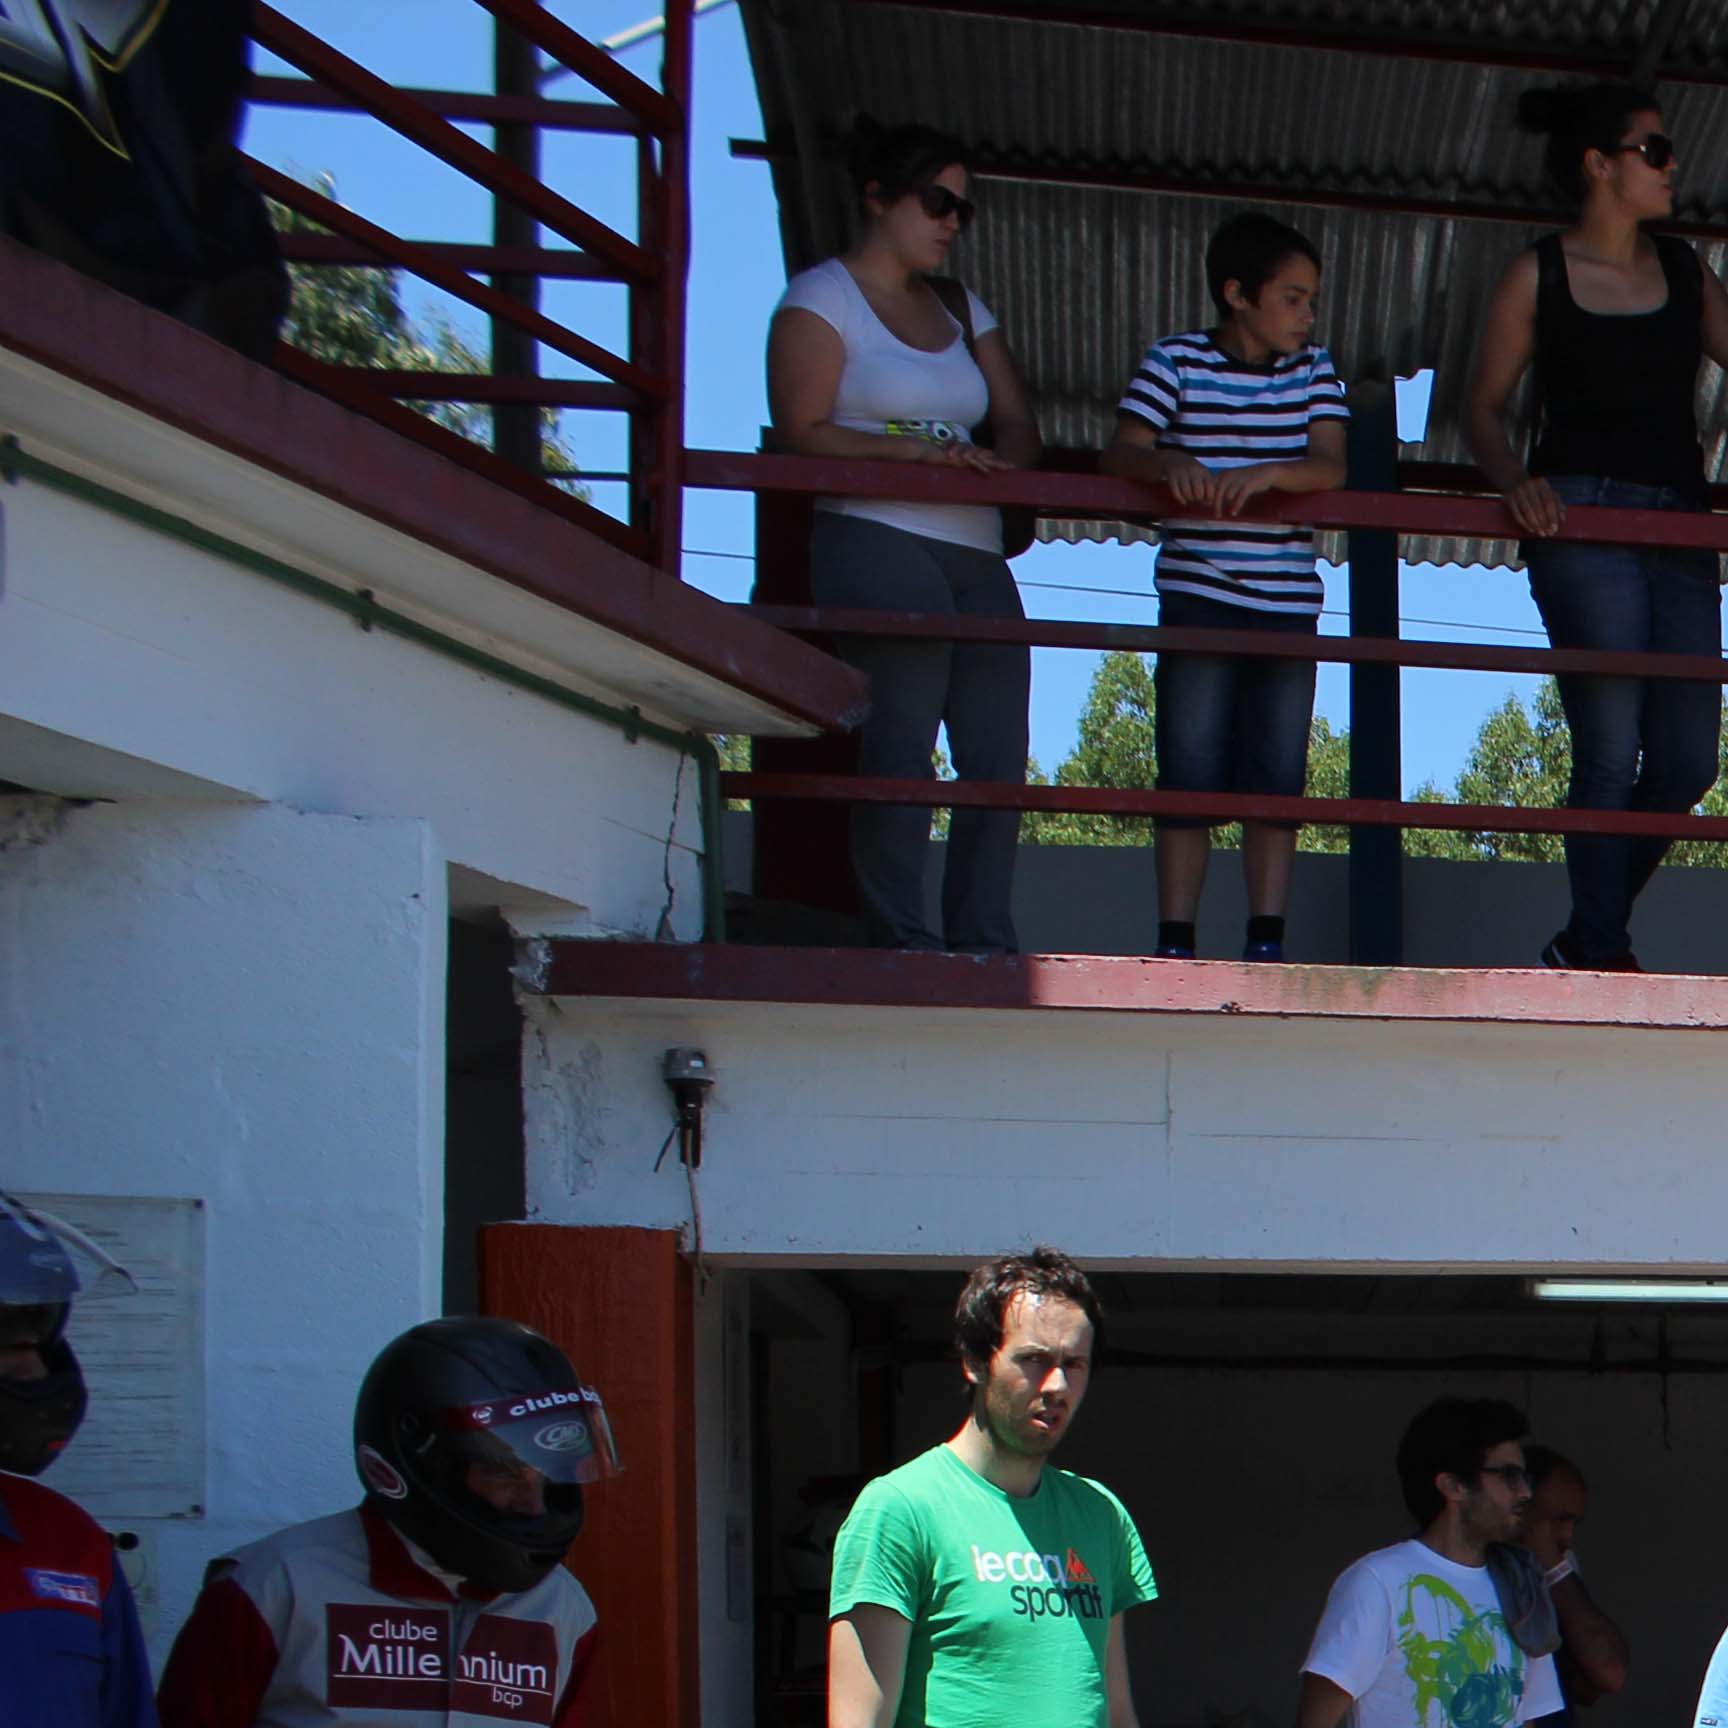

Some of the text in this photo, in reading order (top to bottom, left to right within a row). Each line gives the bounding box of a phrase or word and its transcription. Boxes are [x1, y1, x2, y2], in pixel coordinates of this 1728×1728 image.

[509, 1391, 580, 1416] clube
[971, 1544, 1069, 1589] le coq
[1010, 1584, 1104, 1622] sportif
[369, 1618, 438, 1641] clube
[492, 1686, 523, 1709] bcp
